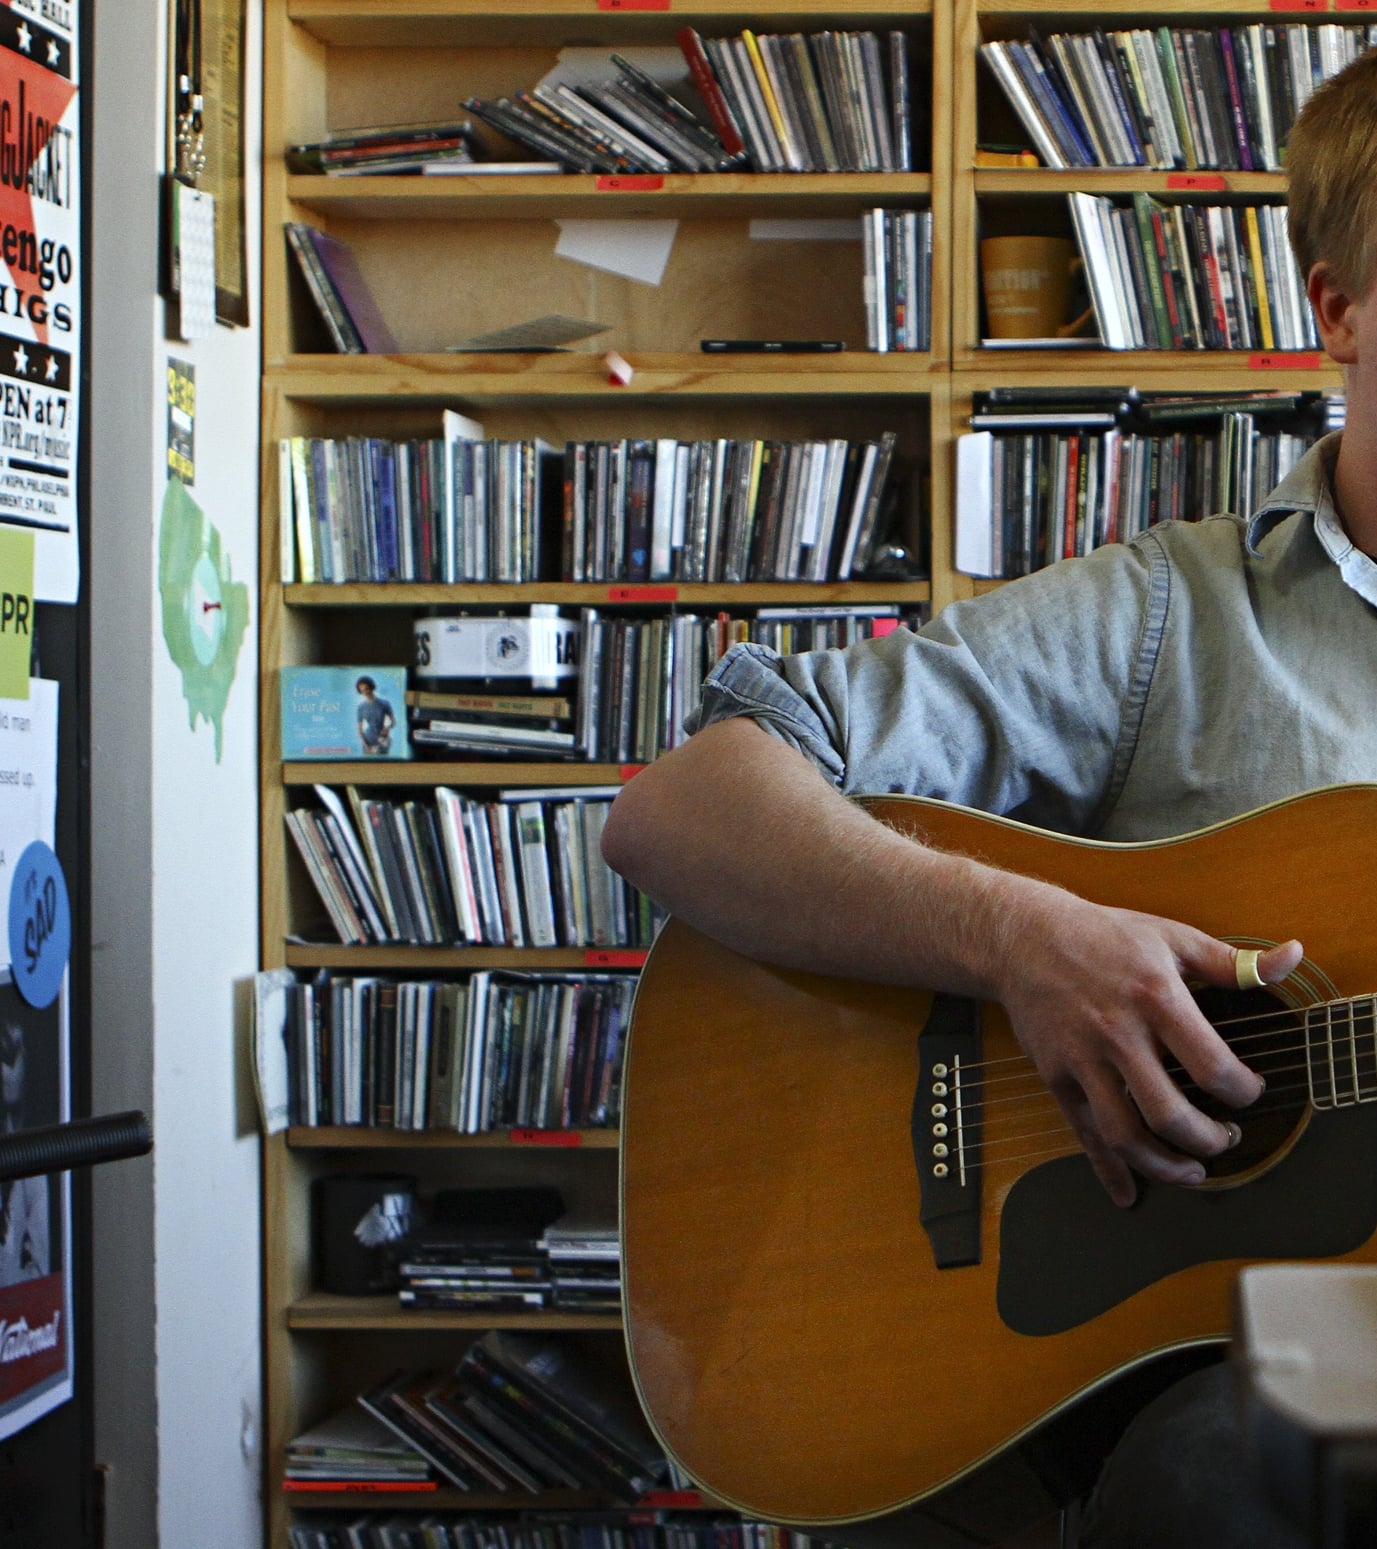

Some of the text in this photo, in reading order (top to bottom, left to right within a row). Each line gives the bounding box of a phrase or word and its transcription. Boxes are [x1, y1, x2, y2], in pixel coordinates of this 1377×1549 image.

[0, 222, 72, 291] engo
[0, 383, 68, 430] EN at 7
[291, 701, 316, 714] Your
